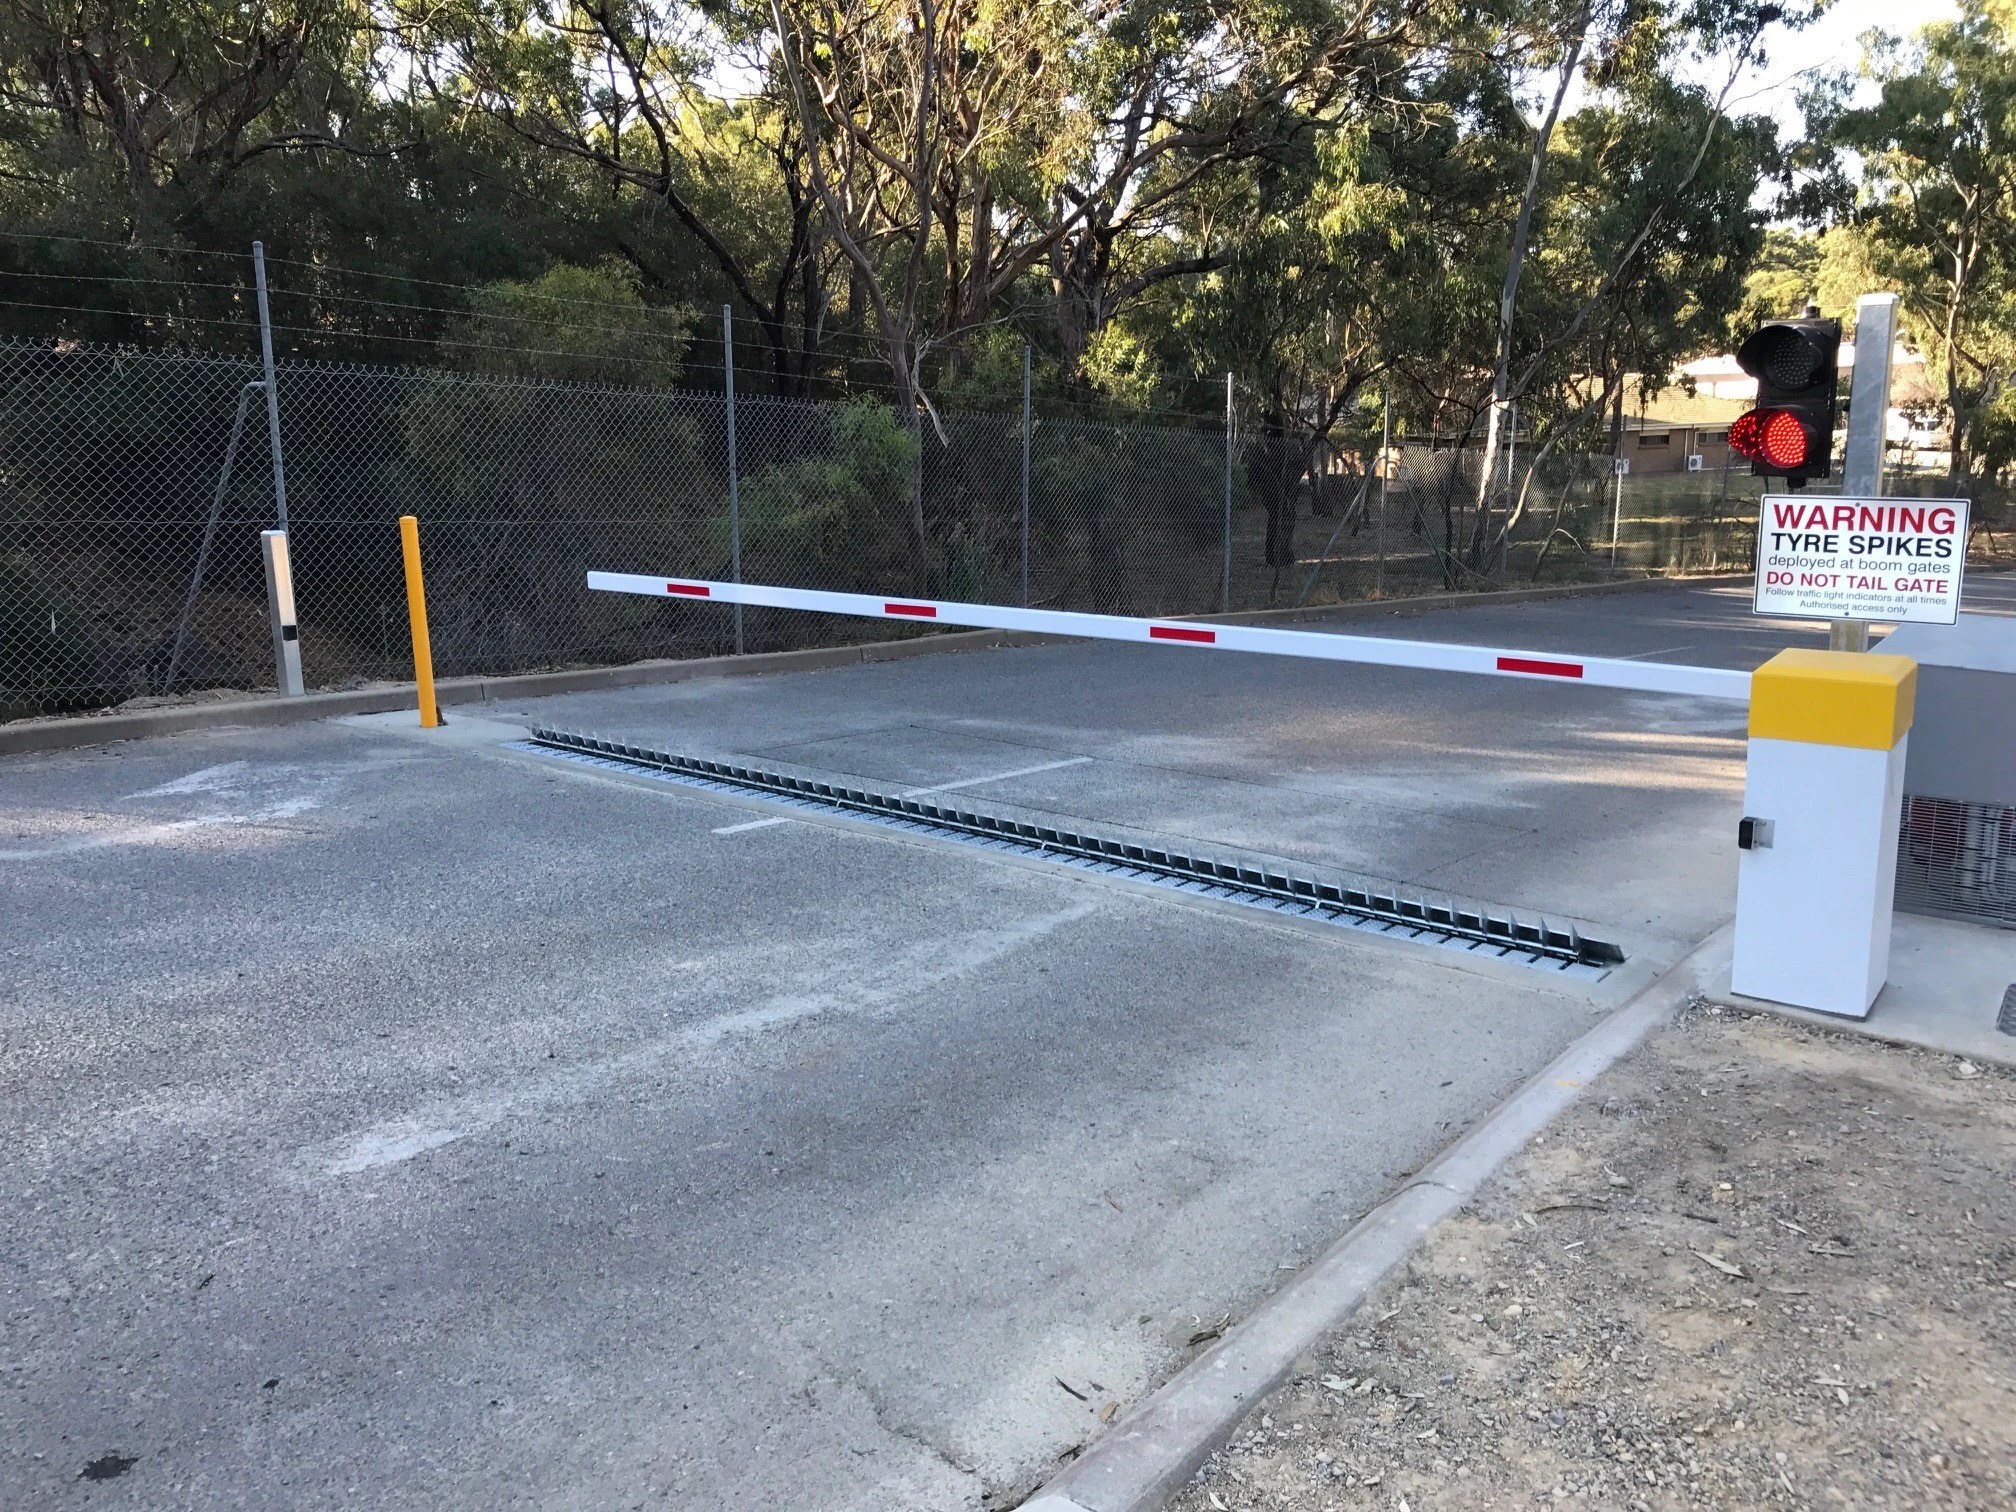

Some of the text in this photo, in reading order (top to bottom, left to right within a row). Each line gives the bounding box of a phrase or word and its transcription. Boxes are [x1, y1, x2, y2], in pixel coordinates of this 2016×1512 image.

[1773, 504, 1956, 535] WARNING
[1771, 532, 1953, 558] TYRE SPIKES
[1768, 554, 1951, 575] deployed at boom gates
[1766, 571, 1949, 594] DO NOT TAIL GATE
[1765, 587, 1947, 606] Follow traffic light indicators at all times
[1799, 600, 1908, 615] Authorised access only
